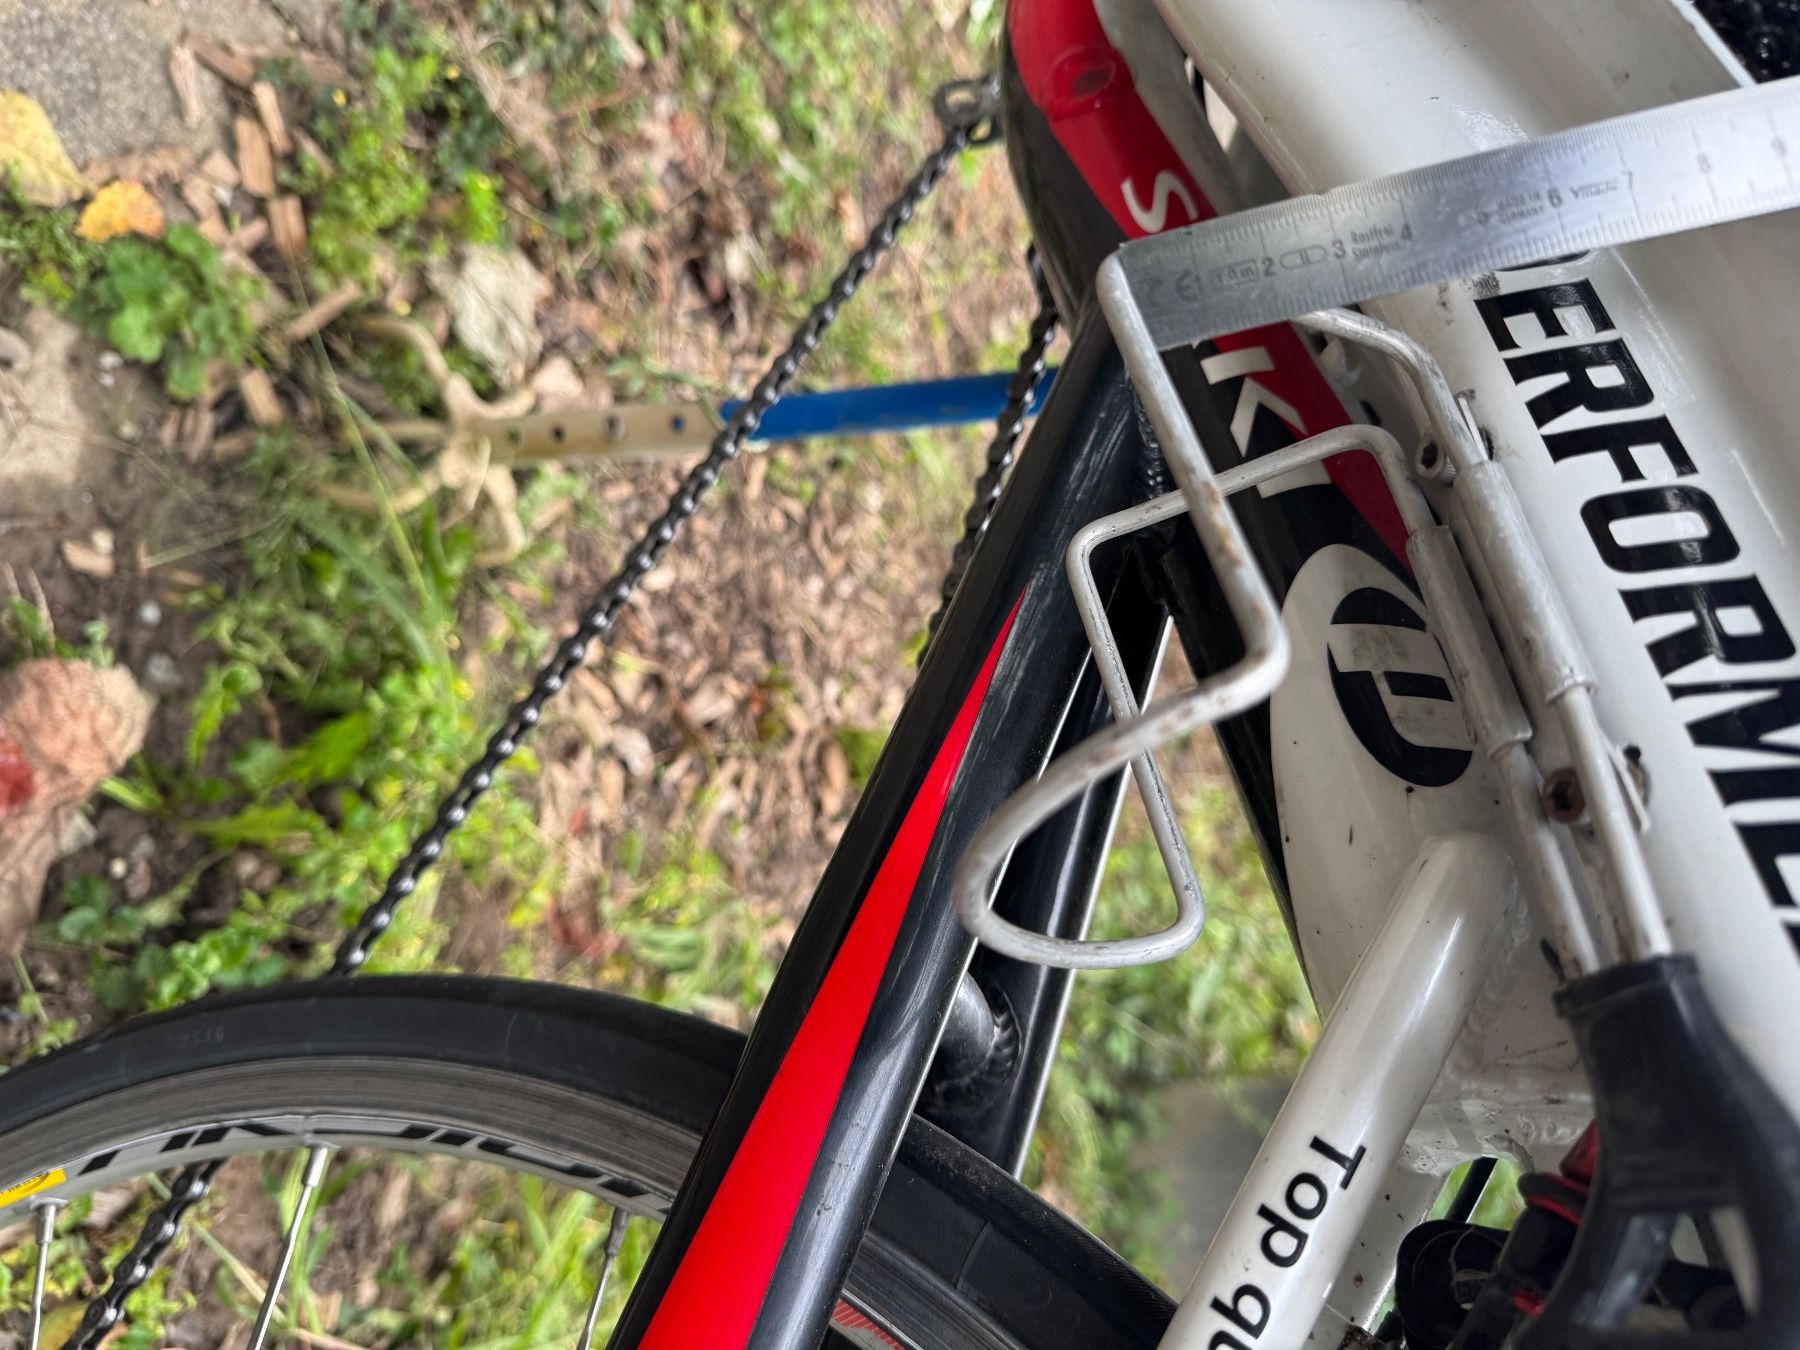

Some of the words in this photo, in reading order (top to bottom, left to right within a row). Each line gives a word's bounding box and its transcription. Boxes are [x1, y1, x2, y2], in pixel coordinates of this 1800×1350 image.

[1261, 256, 1276, 278] 2
[1331, 238, 1347, 260] 3
[1401, 221, 1414, 241] 4
[1547, 187, 1563, 209] 6
[1621, 168, 1635, 191] 7
[1257, 1135, 1367, 1268] Top
